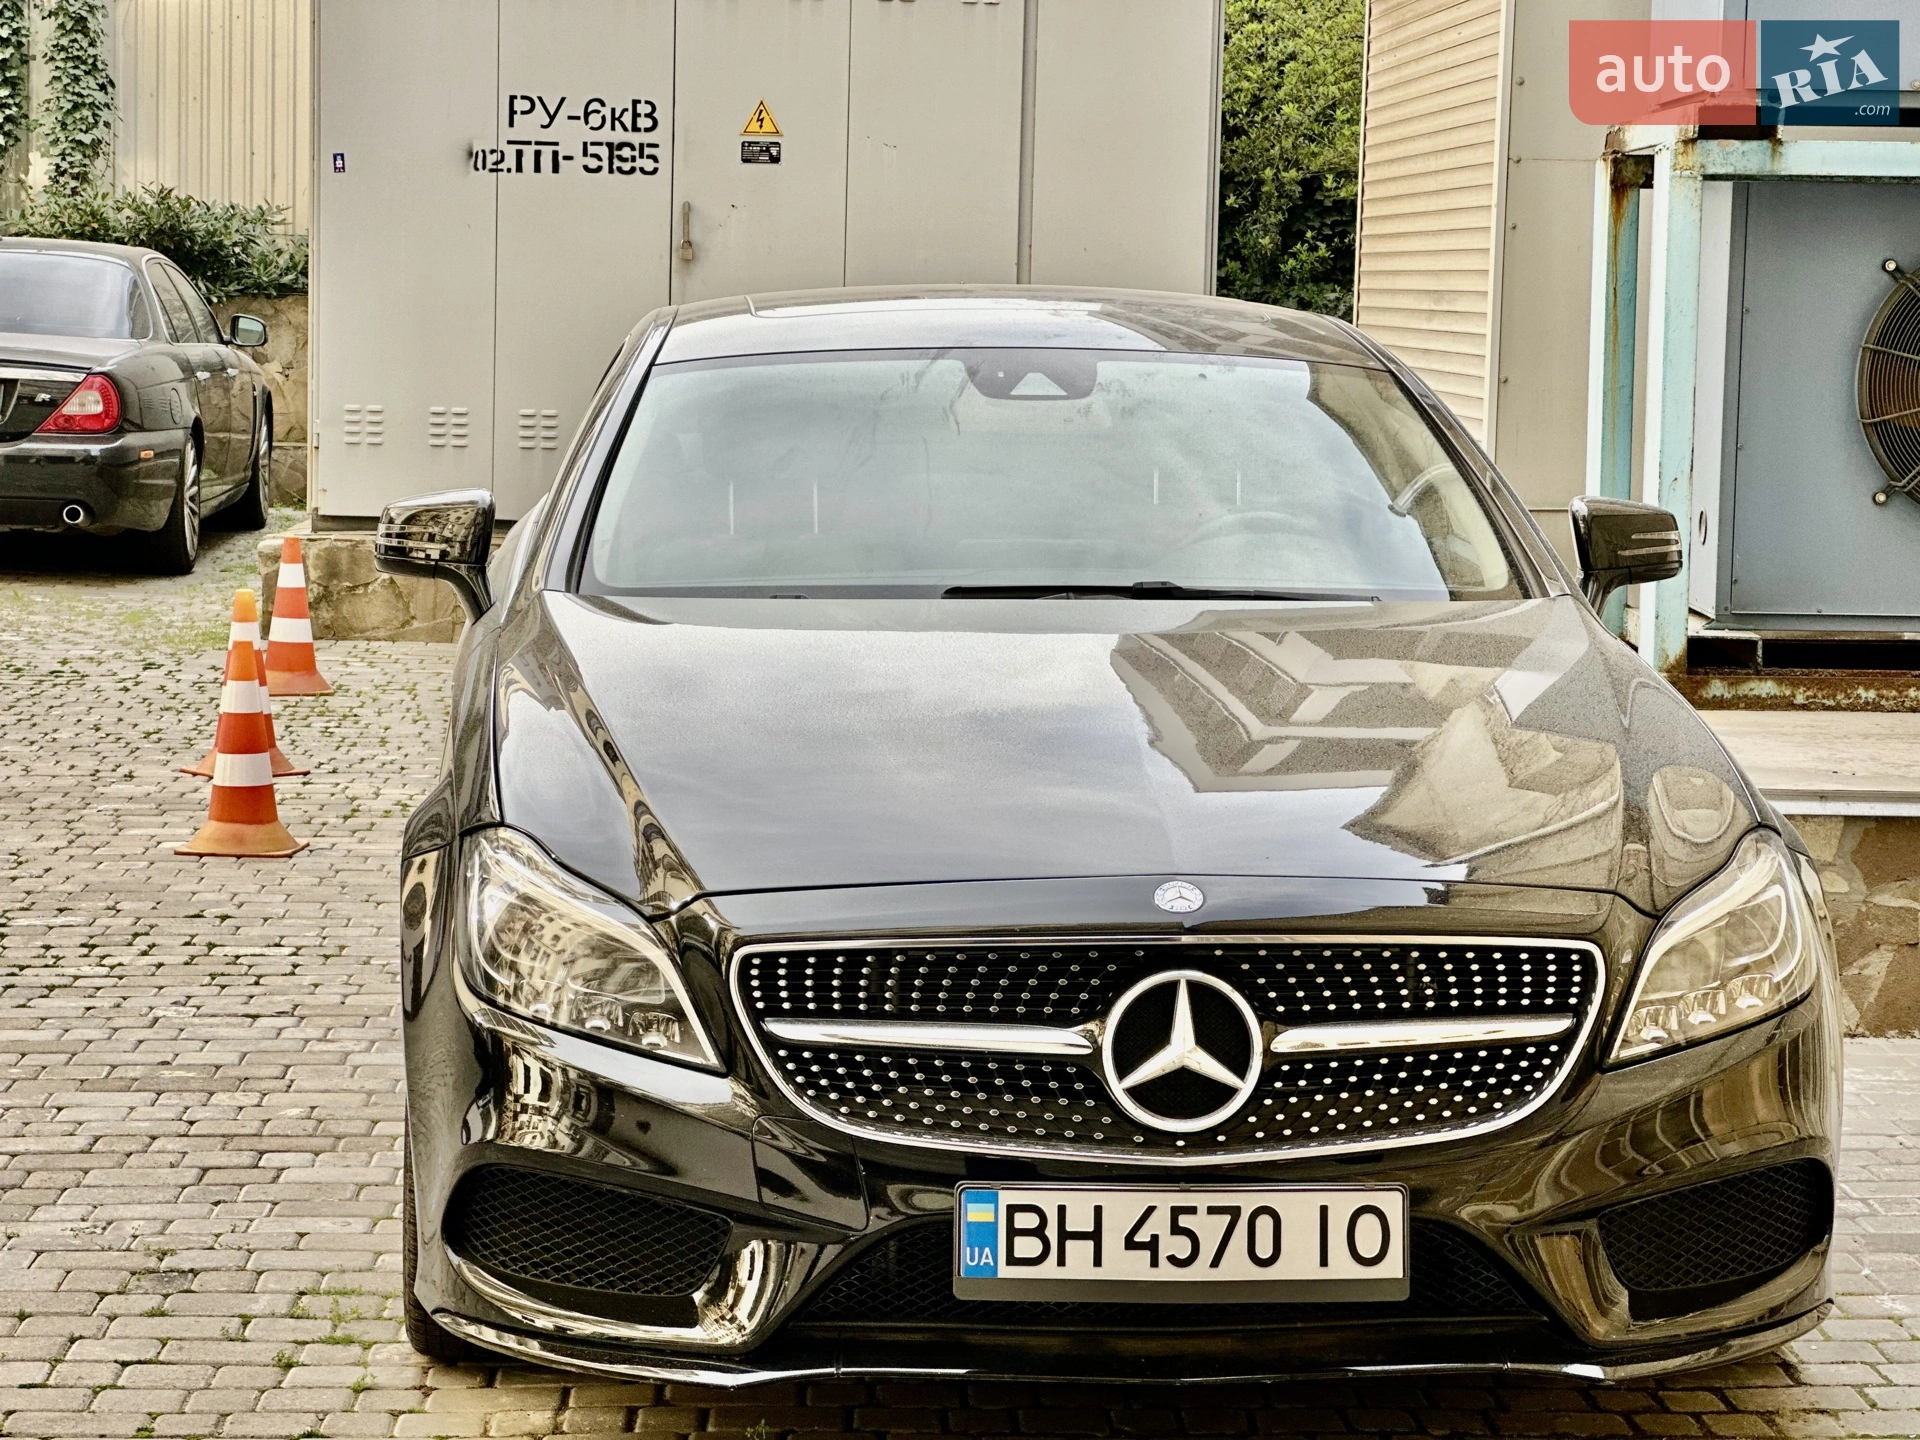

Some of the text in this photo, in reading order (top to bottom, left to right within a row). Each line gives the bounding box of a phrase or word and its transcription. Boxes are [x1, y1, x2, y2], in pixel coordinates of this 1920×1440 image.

[966, 1247, 994, 1267] UA
[1005, 1203, 1103, 1268] BH
[1123, 1204, 1283, 1269] 4570
